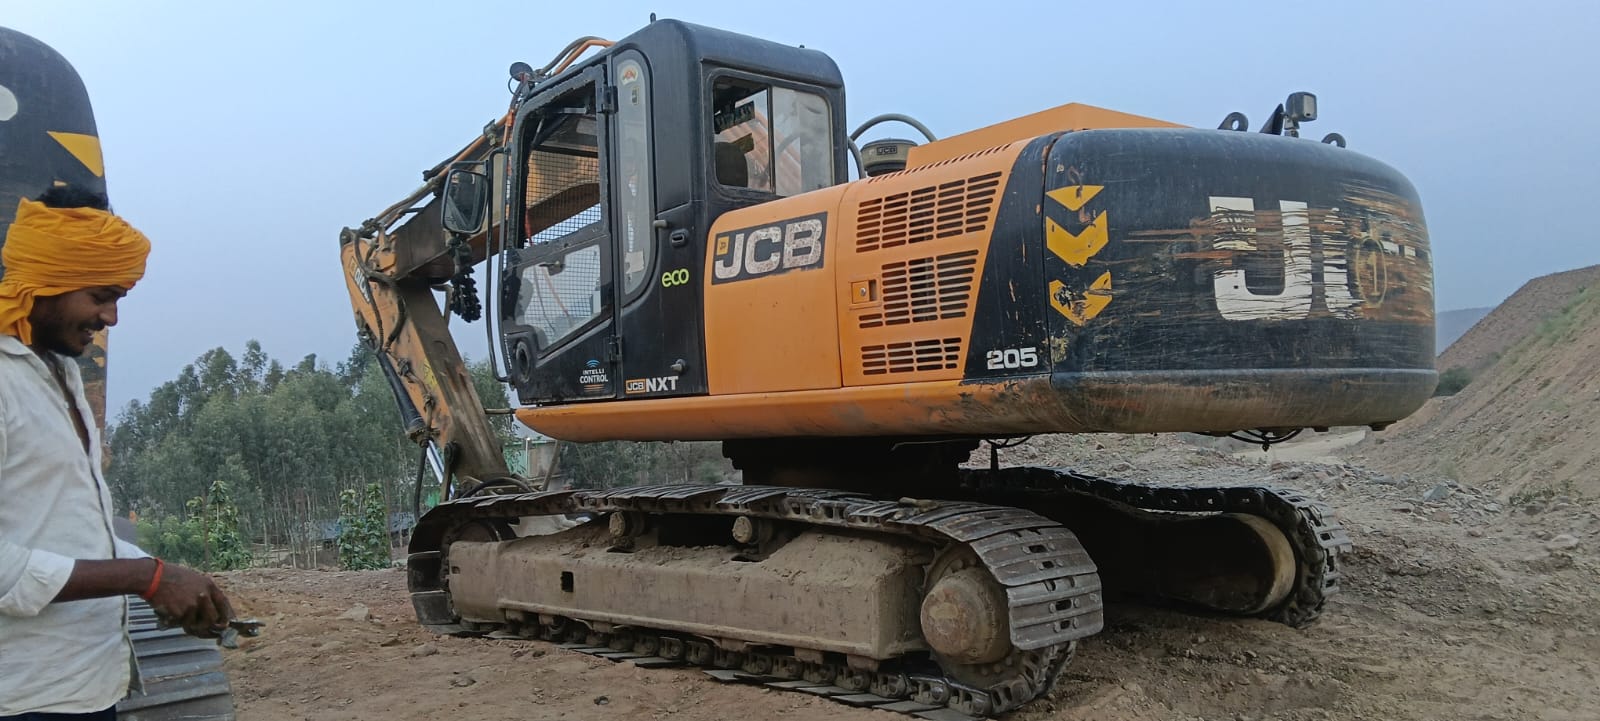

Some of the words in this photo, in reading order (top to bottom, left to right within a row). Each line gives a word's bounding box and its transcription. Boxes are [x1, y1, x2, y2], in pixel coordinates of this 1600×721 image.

[714, 218, 823, 279] JCB
[661, 268, 690, 288] eco
[986, 346, 1039, 370] 205
[580, 374, 609, 384] CONTROL
[626, 381, 645, 392] JCB
[646, 375, 679, 393] NXT
